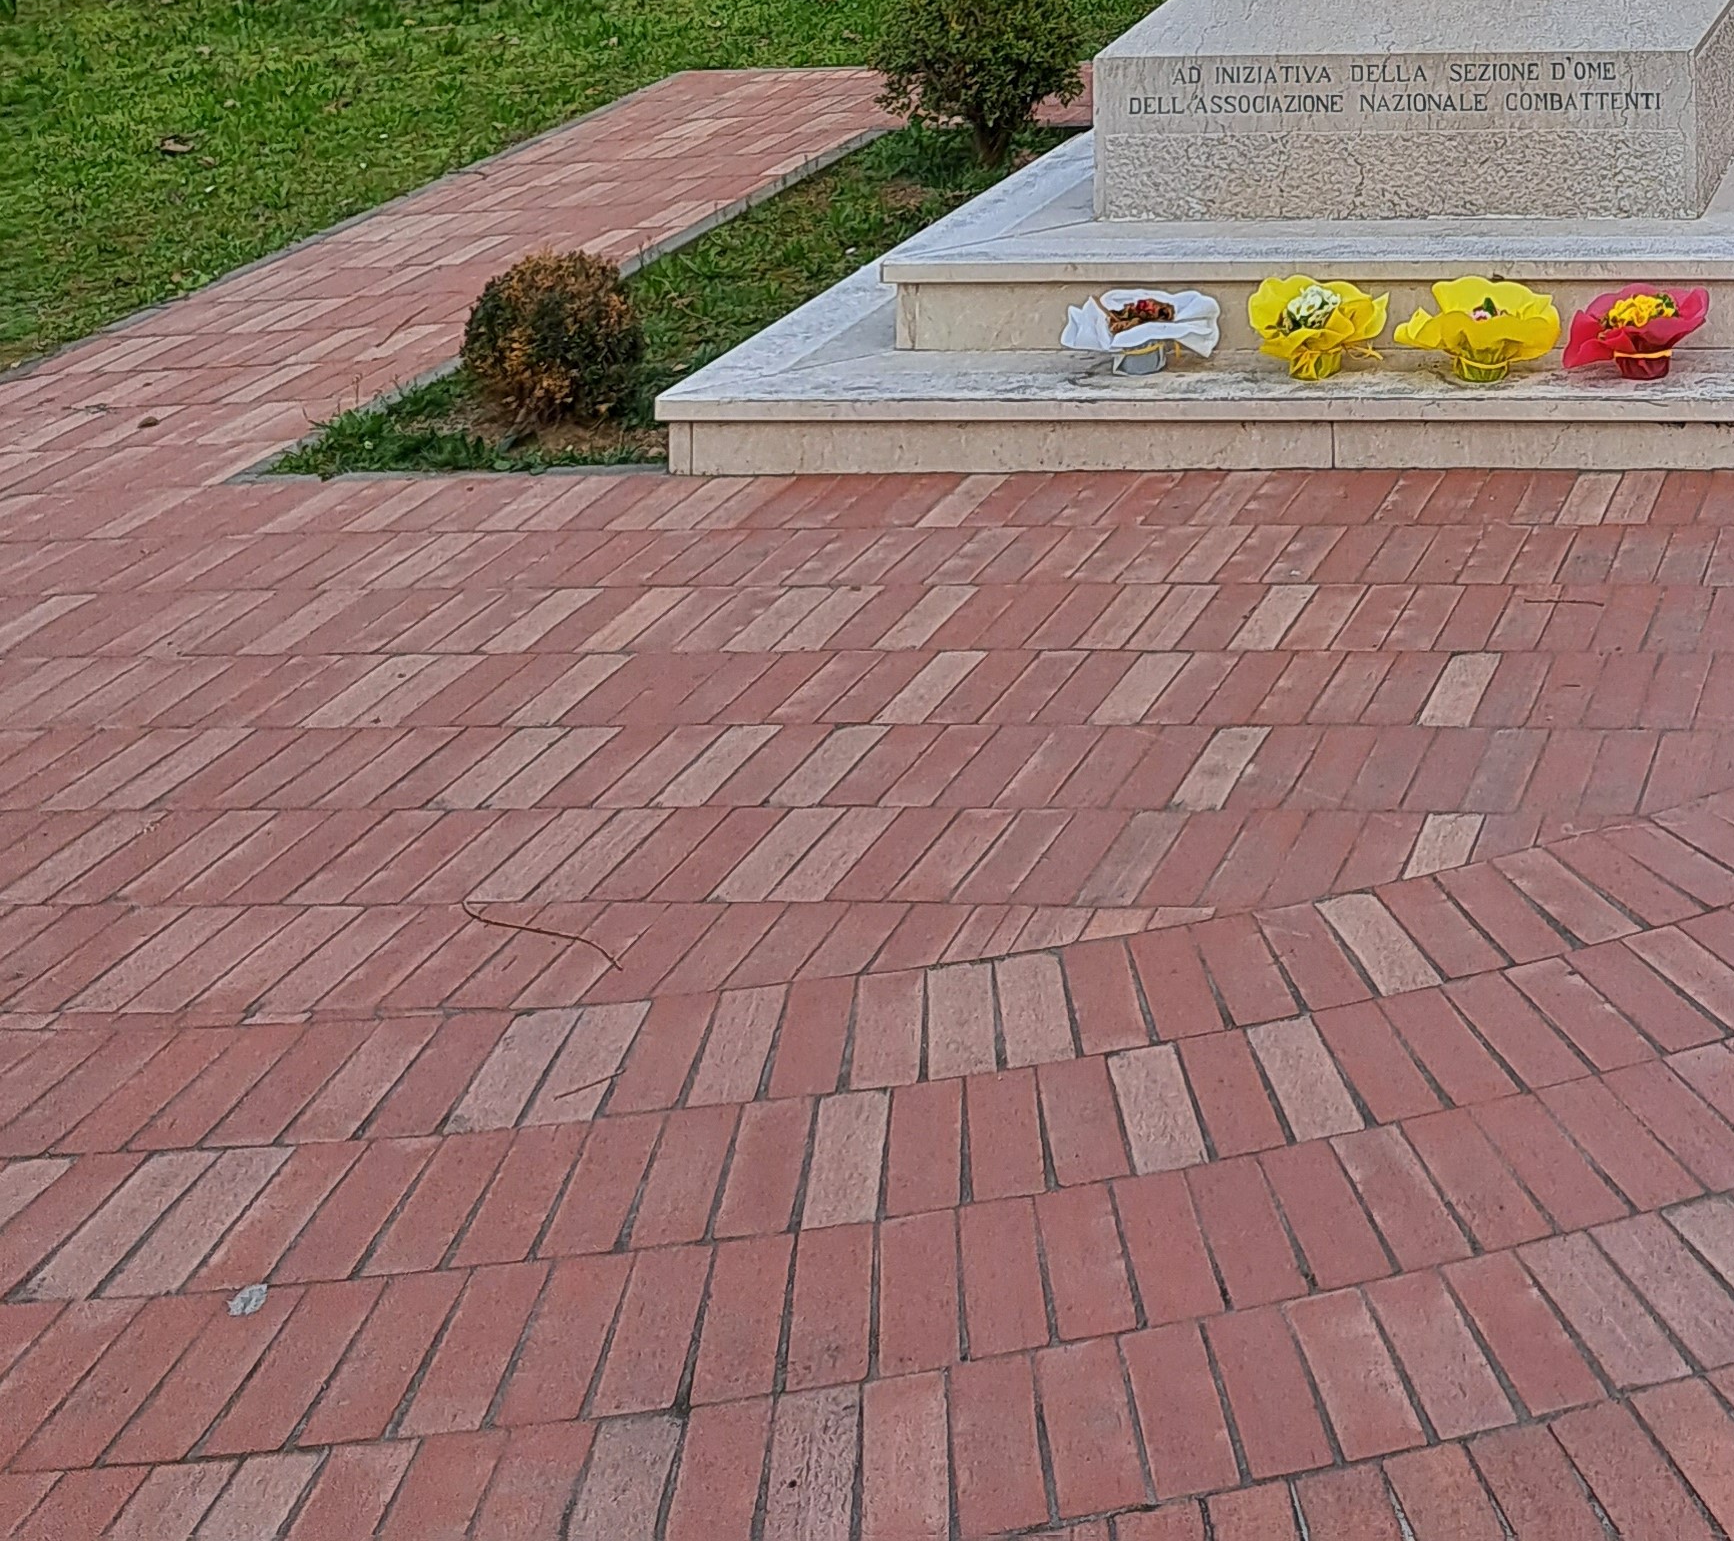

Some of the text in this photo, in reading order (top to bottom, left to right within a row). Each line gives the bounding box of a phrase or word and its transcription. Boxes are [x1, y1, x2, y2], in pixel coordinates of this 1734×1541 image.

[1172, 57, 1616, 85] AD INIZIATIVA DELLA SEZIONE D'OME
[1360, 93, 1488, 113] NAZIONALE
[1505, 92, 1661, 111] COMBATTENTI
